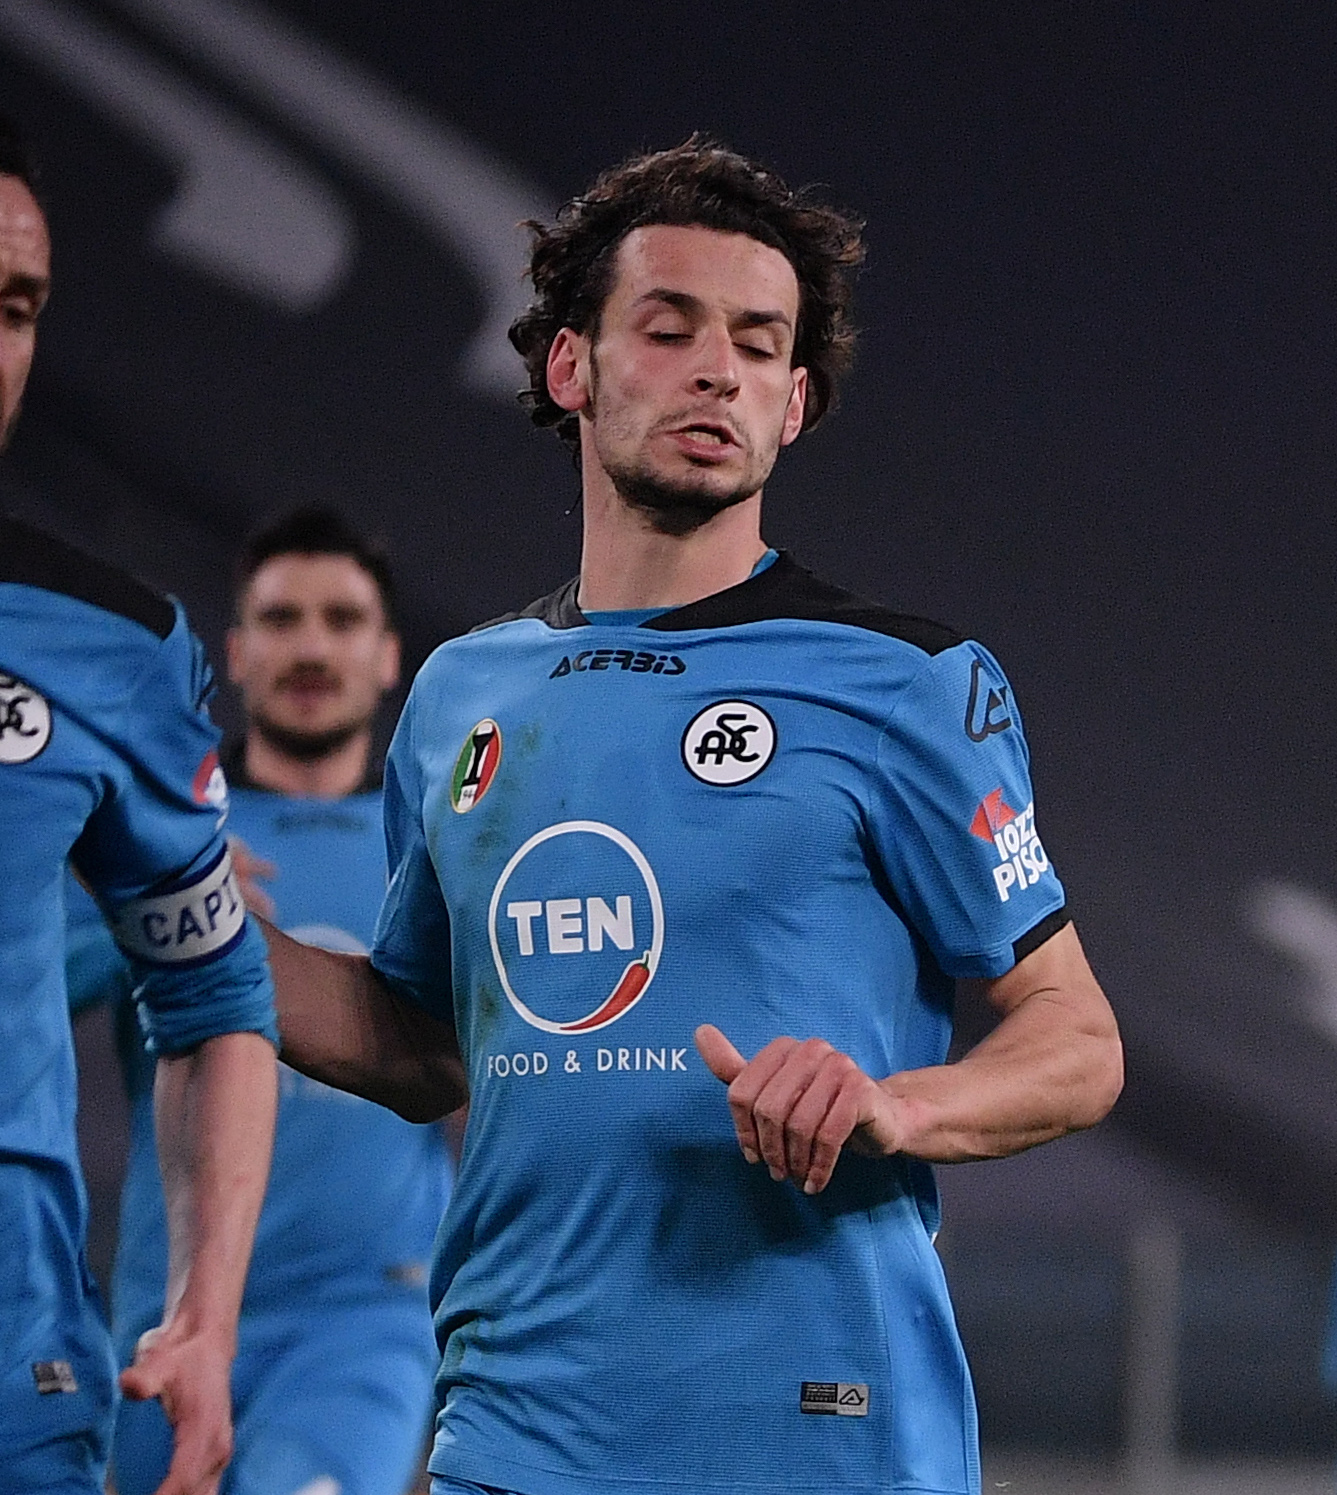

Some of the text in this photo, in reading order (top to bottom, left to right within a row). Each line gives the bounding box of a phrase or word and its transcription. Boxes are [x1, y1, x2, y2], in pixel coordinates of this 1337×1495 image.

[507, 895, 635, 956] TEN
[488, 1047, 688, 1078] FOOD & DRINK
